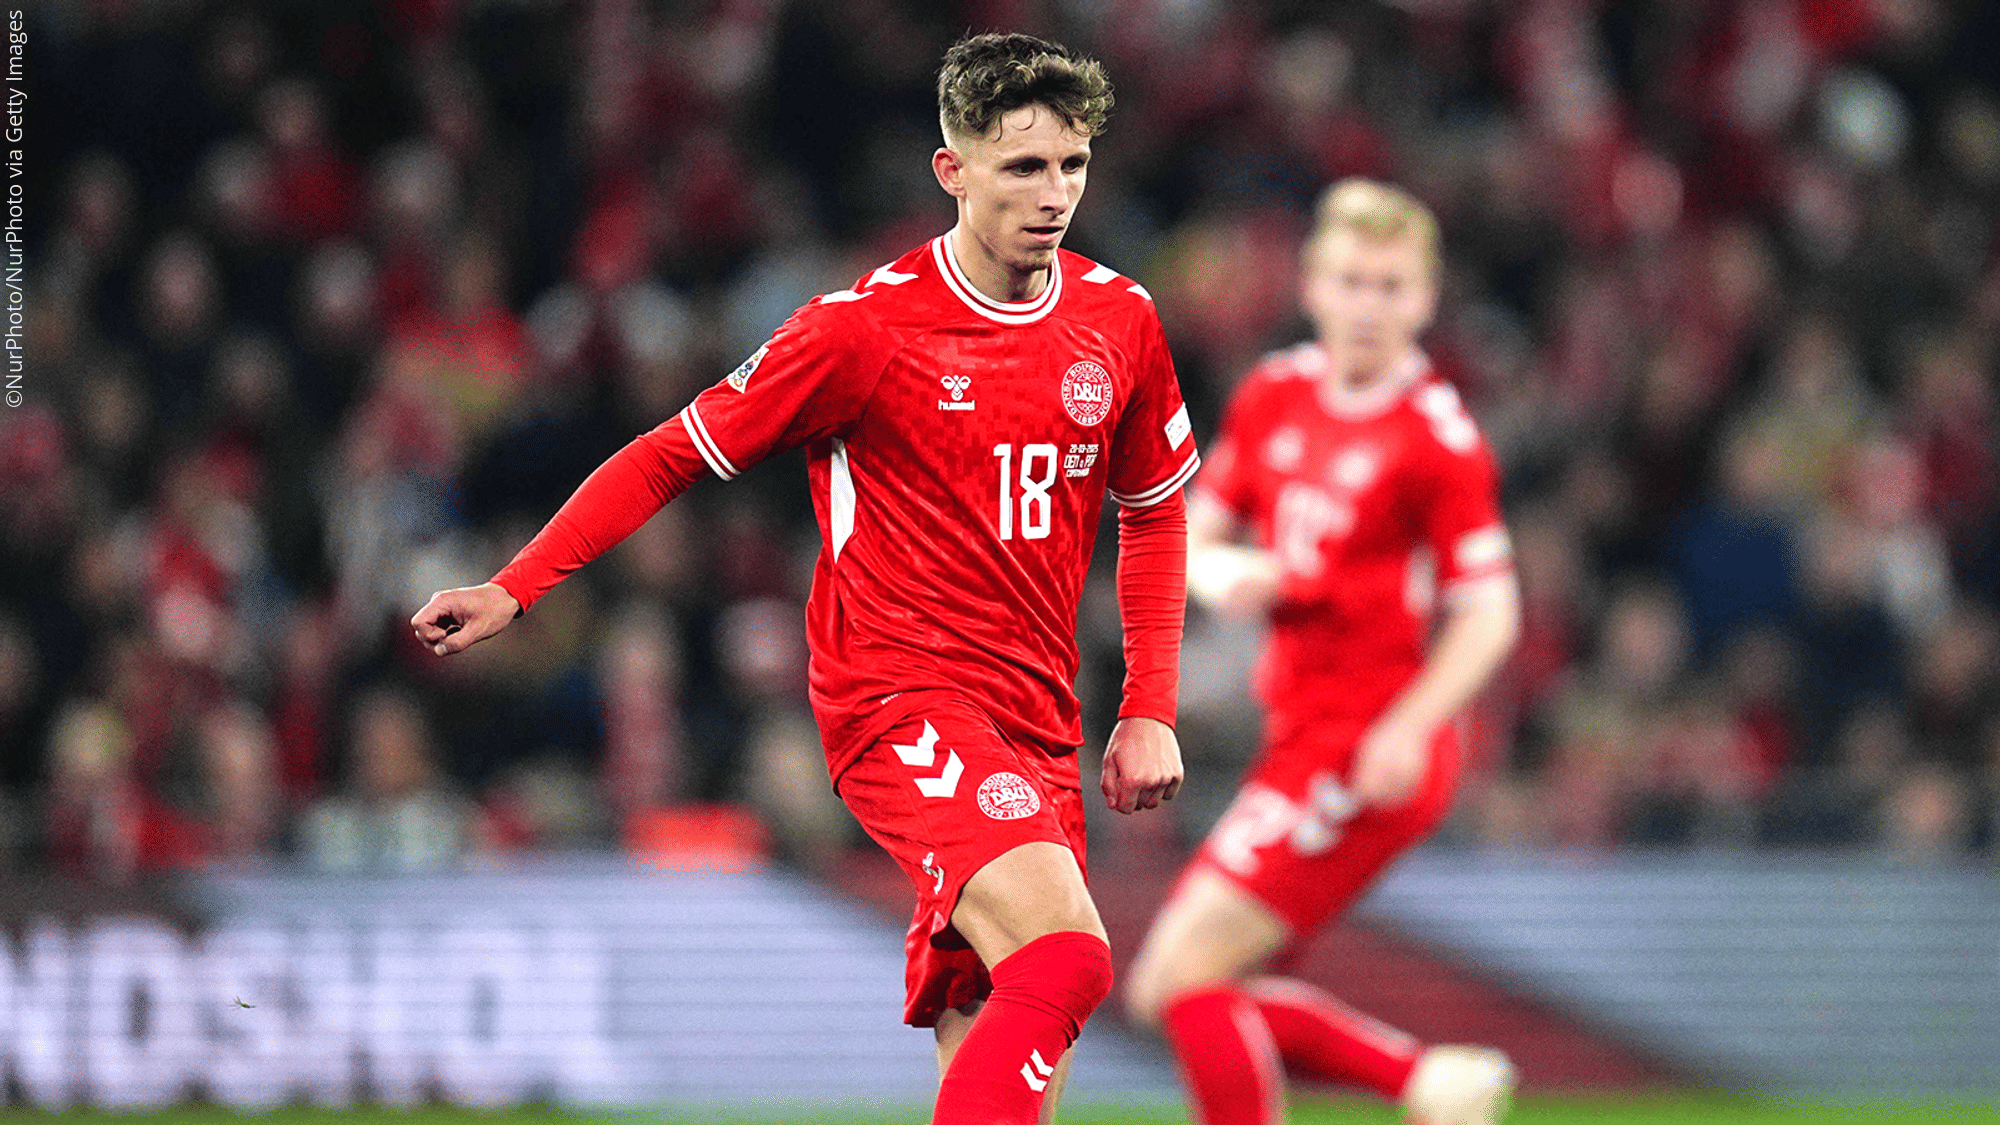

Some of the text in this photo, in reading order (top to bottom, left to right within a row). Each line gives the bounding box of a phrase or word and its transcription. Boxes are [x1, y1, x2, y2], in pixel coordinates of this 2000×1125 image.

[1073, 382, 1103, 402] DBU
[938, 399, 975, 411] hummel
[993, 443, 1058, 540] 18
[989, 786, 1029, 806] DBU
